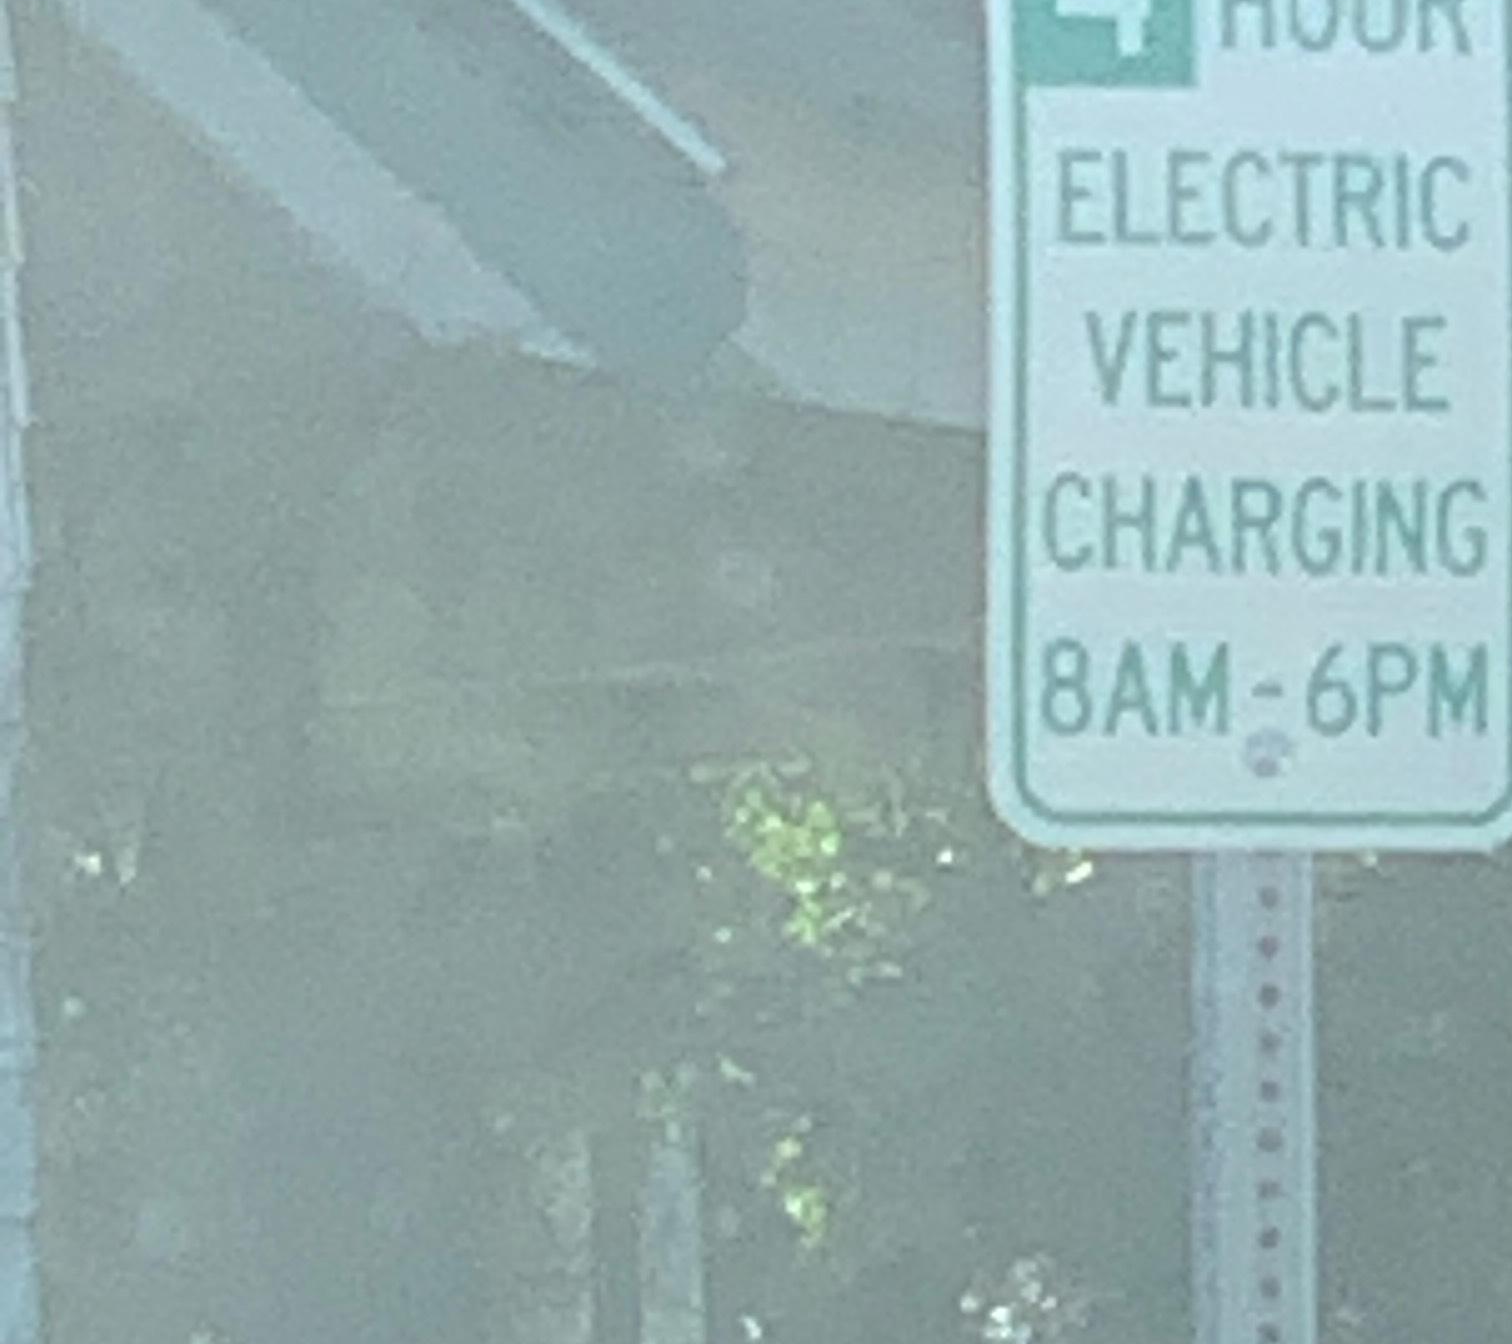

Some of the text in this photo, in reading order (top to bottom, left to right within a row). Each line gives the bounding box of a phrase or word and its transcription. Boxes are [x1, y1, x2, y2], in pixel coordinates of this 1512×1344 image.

[1056, 148, 1472, 251] ELECTRIC
[1084, 308, 1451, 413] VEHICLE
[1042, 470, 1488, 577] CHARGING
